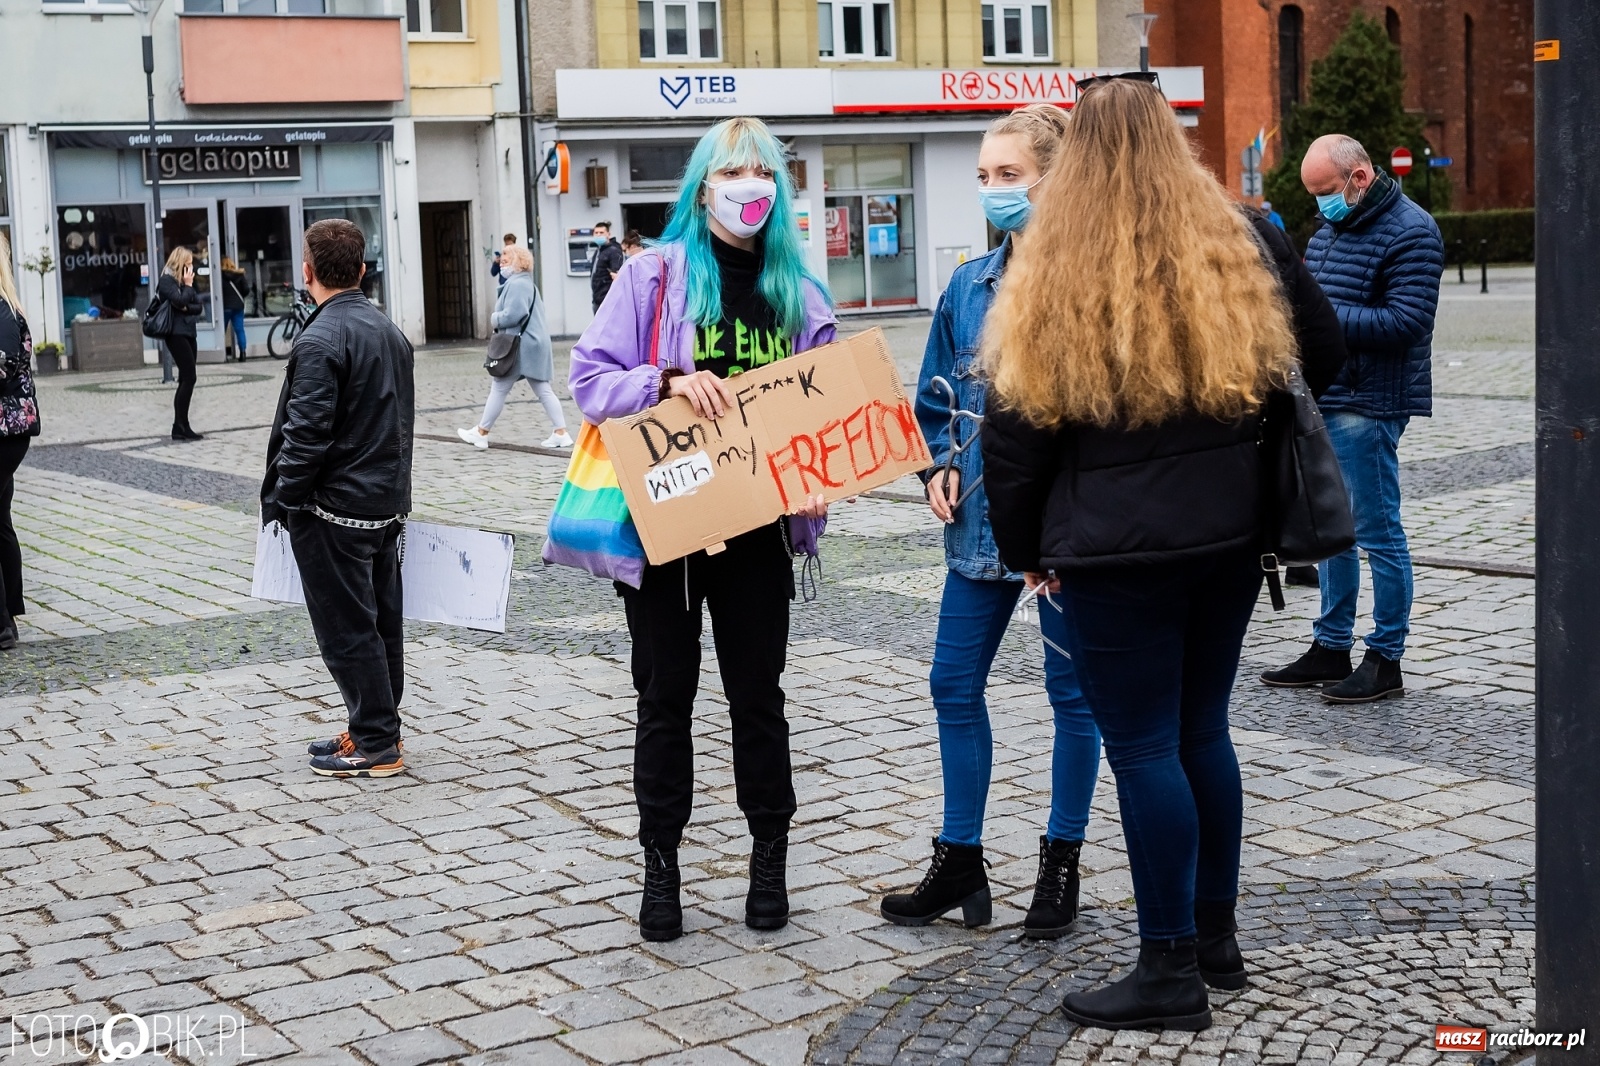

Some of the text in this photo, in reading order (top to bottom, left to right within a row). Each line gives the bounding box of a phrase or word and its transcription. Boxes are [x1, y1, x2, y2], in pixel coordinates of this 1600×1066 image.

[694, 76, 736, 93] TEB
[941, 71, 1110, 101] ROSSMAN
[694, 96, 737, 105] EDUKACJA
[285, 130, 327, 142] gelatopiu
[160, 146, 291, 179] gelatopiu
[64, 248, 146, 271] gelatopiu
